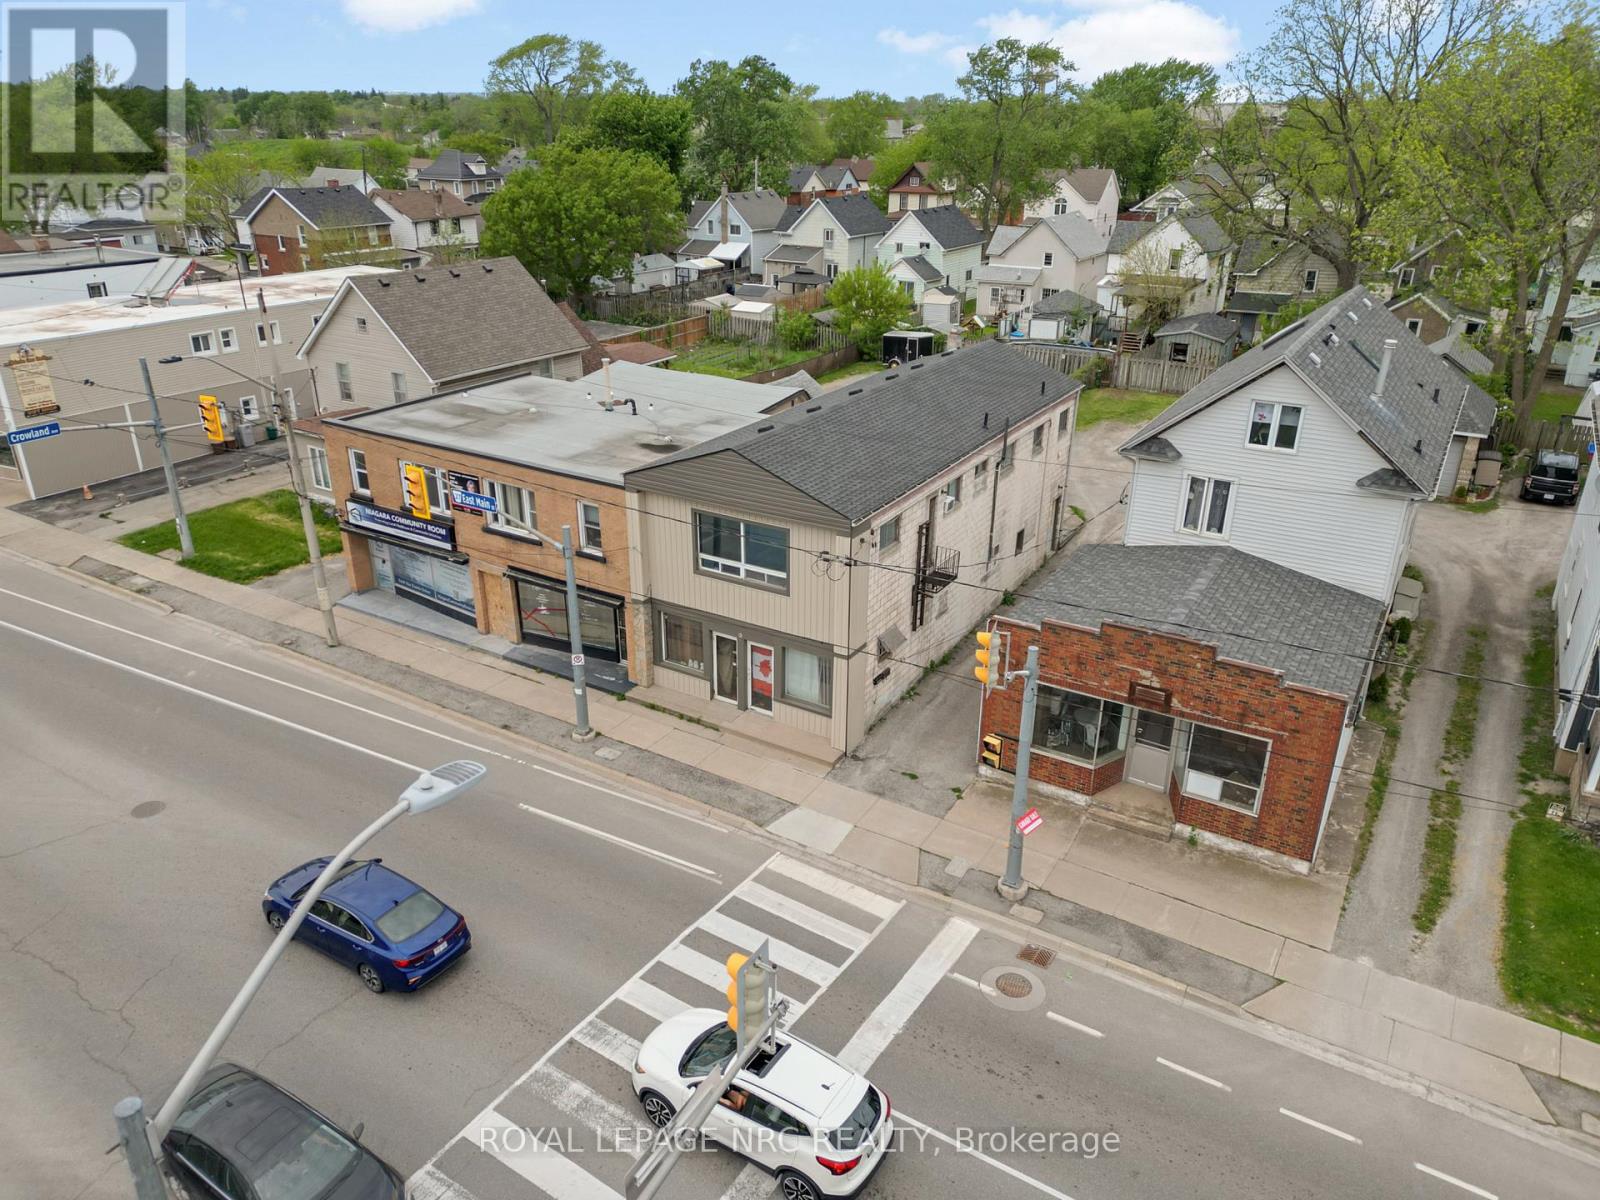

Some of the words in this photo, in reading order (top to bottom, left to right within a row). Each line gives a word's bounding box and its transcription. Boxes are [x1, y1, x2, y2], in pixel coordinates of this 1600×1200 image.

[10, 426, 50, 443] Crowland
[462, 493, 475, 506] East
[475, 497, 491, 511] Main
[365, 508, 391, 521] NIAGARA
[391, 514, 427, 529] COMMUNITY
[427, 524, 446, 535] ROOM
